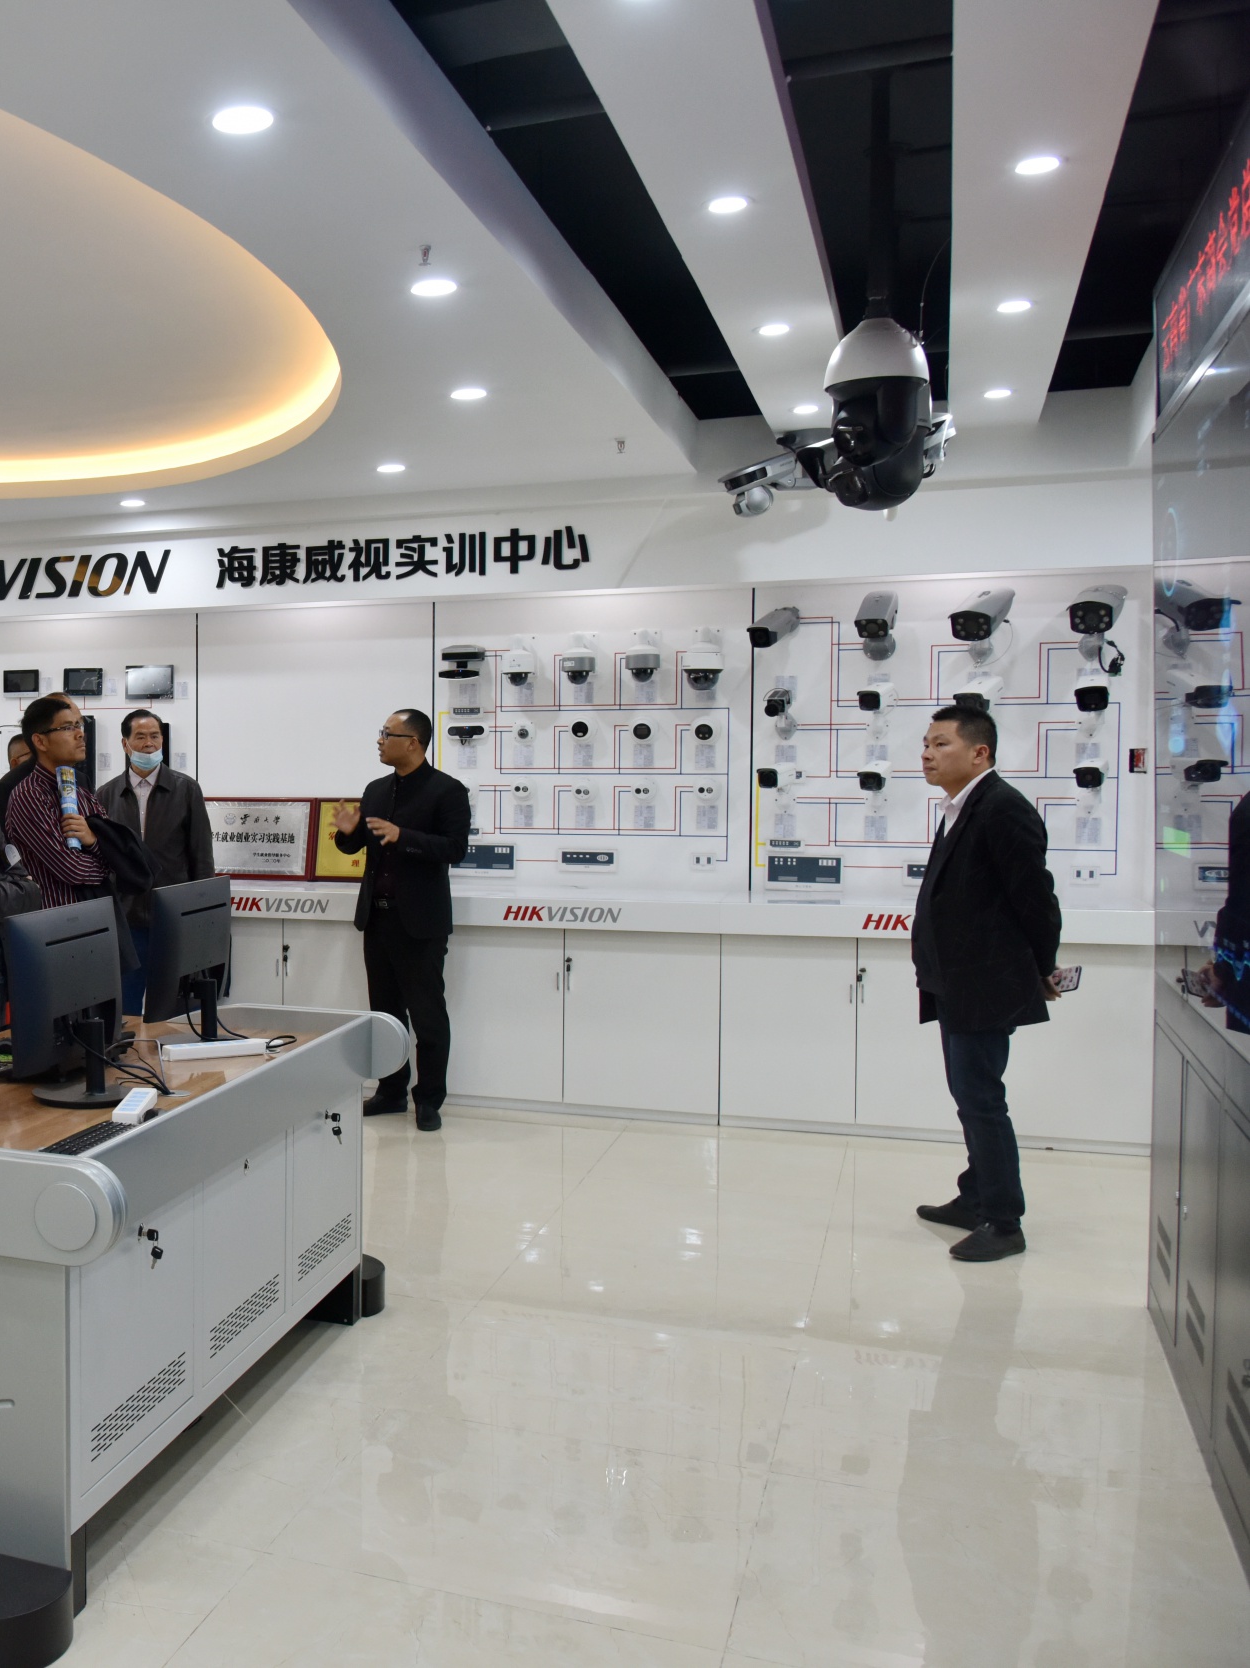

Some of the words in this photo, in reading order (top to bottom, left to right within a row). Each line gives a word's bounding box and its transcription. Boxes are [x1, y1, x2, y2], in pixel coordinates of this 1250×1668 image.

[216, 526, 590, 588] 海康威视实训中心
[231, 897, 329, 913] HIKVISION
[503, 905, 622, 923] HIKVISION
